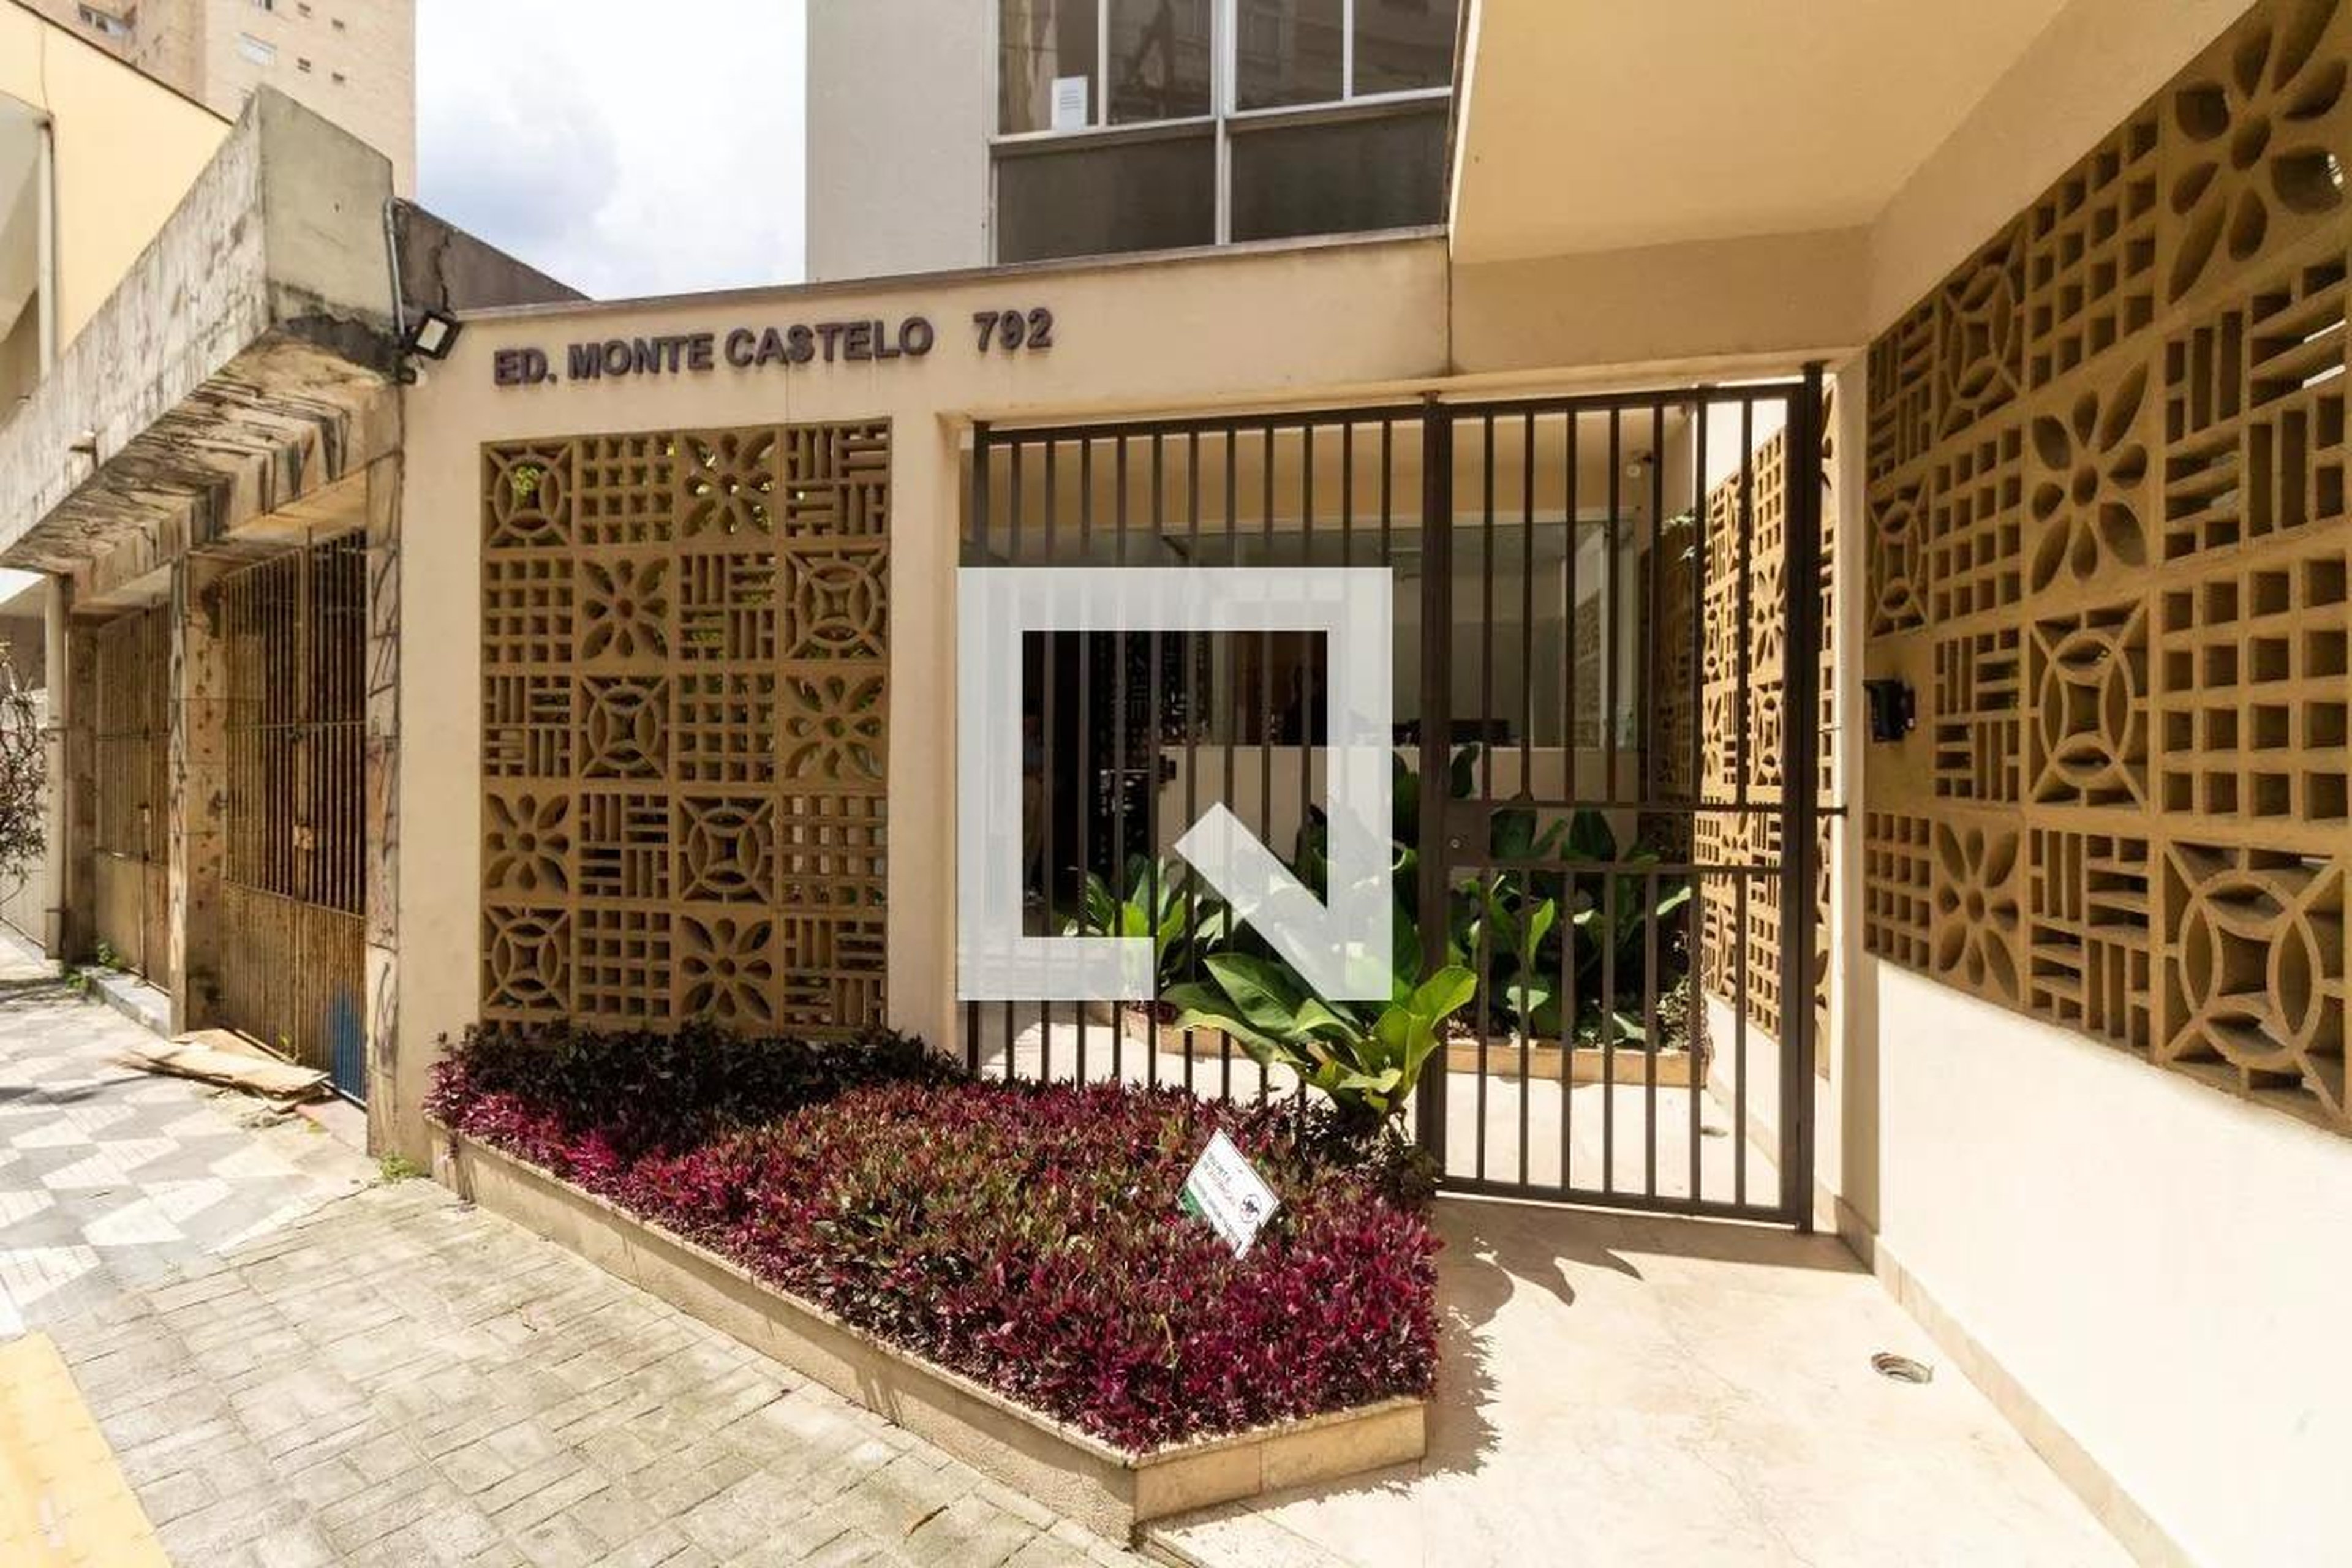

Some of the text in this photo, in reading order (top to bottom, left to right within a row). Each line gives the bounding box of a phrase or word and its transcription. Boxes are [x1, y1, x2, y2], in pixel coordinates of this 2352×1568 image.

[494, 307, 1052, 386] ED. MONTE CASTELO 792
